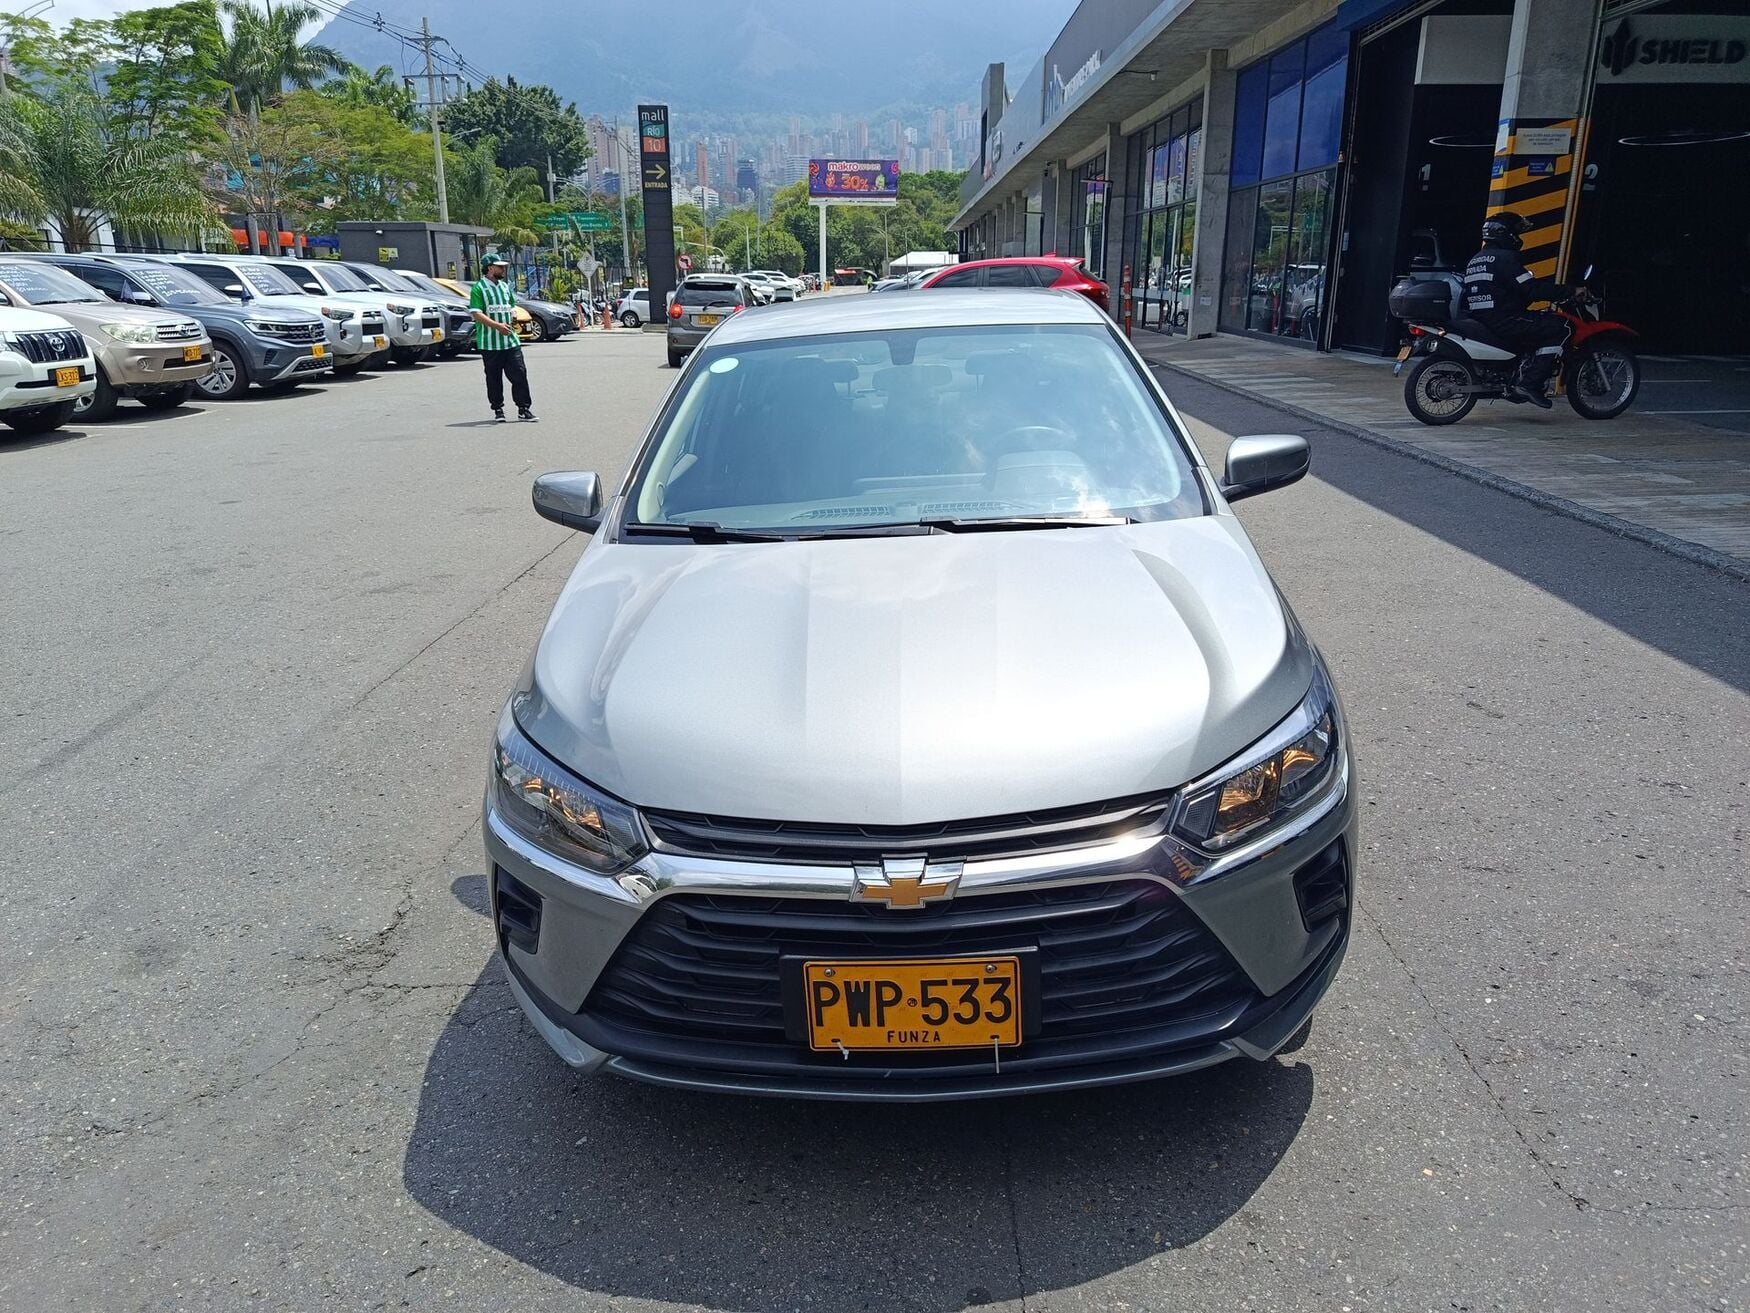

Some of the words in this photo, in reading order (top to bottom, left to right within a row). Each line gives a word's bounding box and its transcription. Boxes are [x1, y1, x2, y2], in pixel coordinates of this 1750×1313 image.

[1639, 39, 1746, 65] SHIELD
[641, 109, 665, 121] mall
[648, 139, 662, 152] 10
[1585, 163, 1599, 180] 2
[841, 175, 869, 190] 30%
[812, 978, 903, 1028] PWP
[920, 976, 1012, 1026] 533
[887, 1030, 941, 1043] FUNZA
